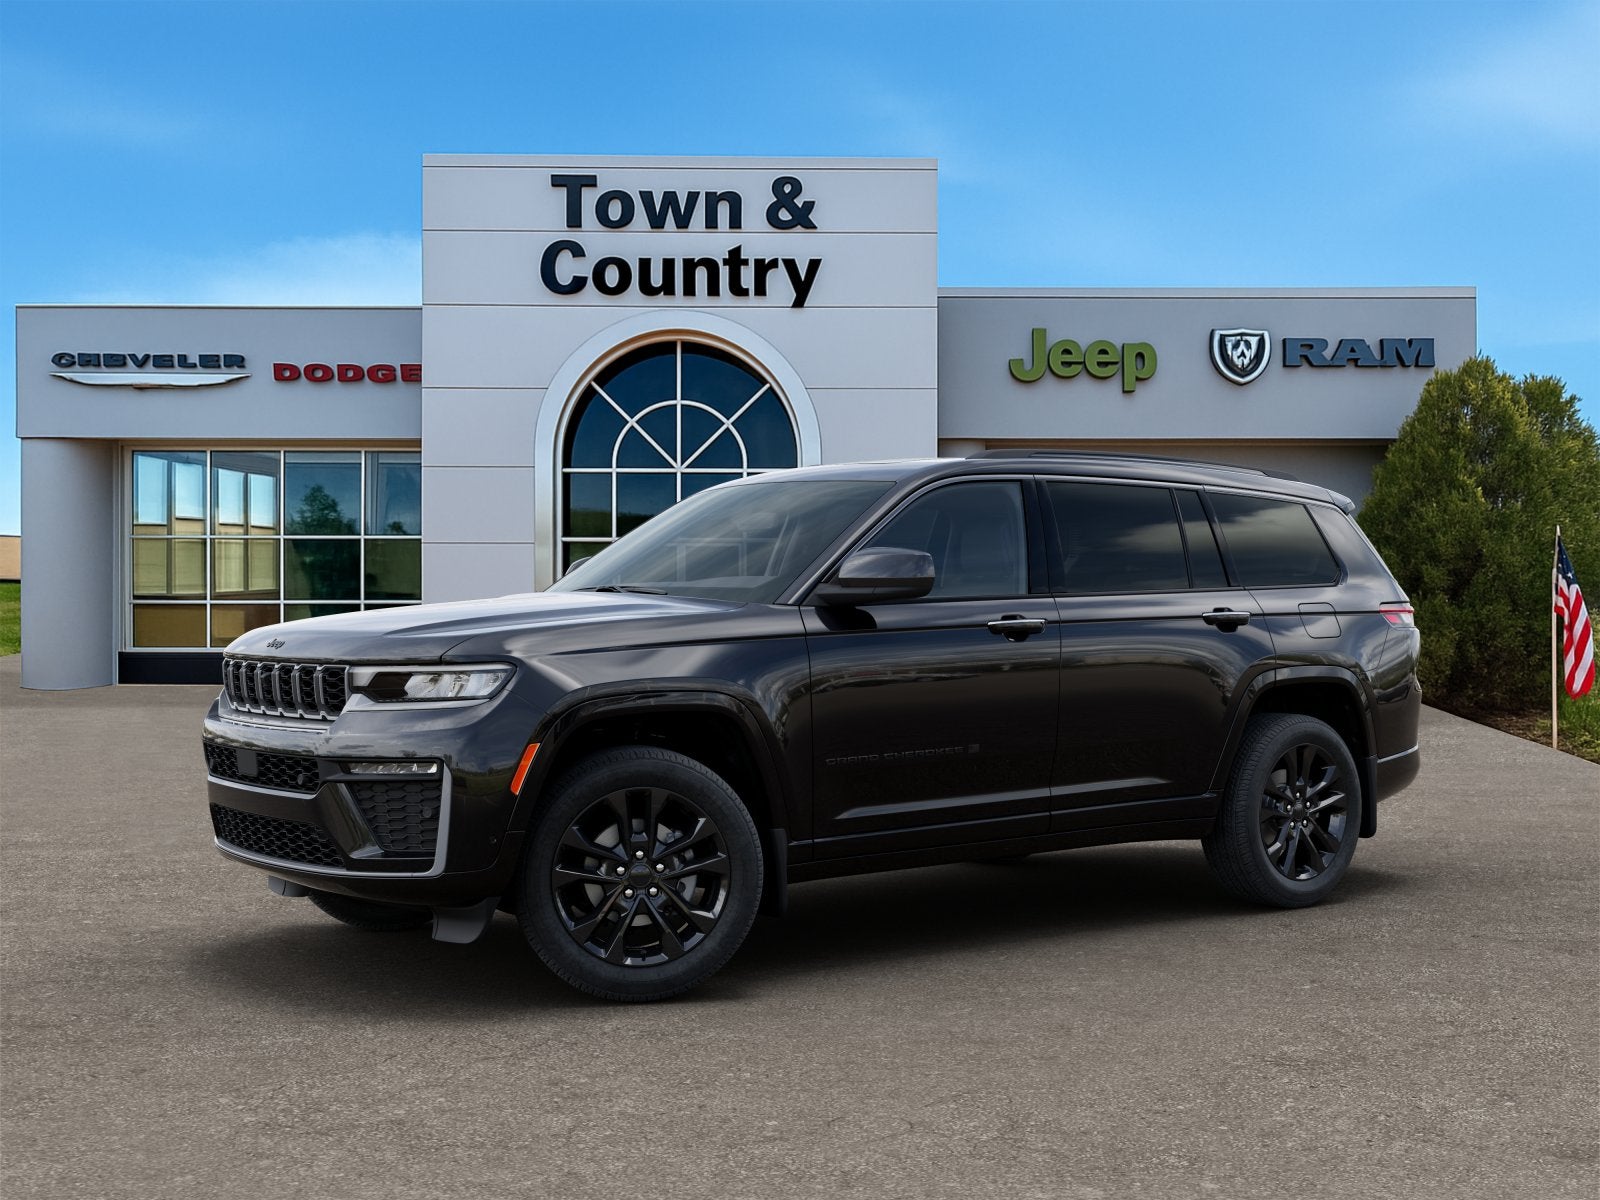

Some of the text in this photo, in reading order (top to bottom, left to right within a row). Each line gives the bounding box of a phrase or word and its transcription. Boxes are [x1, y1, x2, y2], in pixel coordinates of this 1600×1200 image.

[550, 174, 818, 230] Town &
[540, 239, 822, 308] Country
[272, 362, 422, 383] DODGE
[1009, 328, 1158, 393] Jeep
[1282, 337, 1436, 368] RAM
